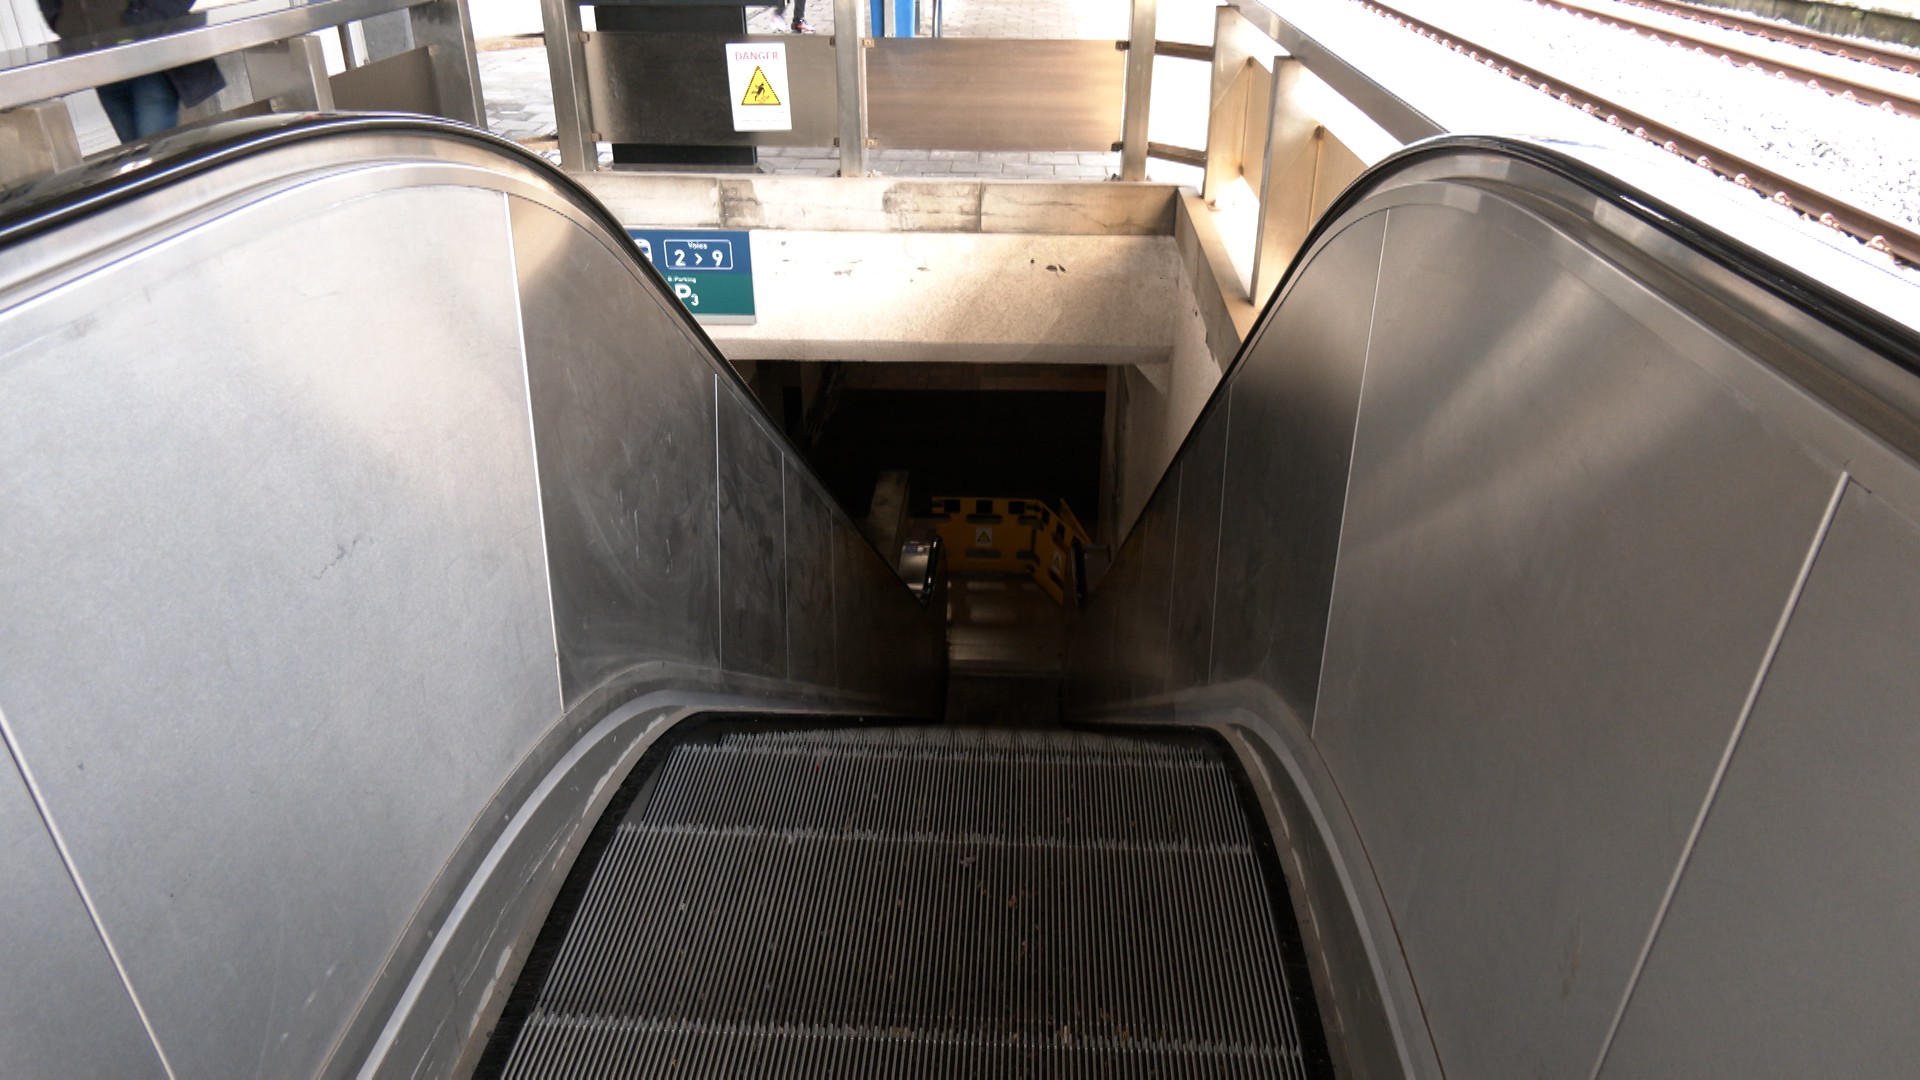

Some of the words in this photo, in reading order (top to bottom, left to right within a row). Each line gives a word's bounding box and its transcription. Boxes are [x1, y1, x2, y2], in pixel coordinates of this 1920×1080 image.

[735, 51, 779, 60] DANGER
[687, 240, 708, 250] Voies
[674, 249, 686, 266] 2
[711, 249, 723, 267] 9
